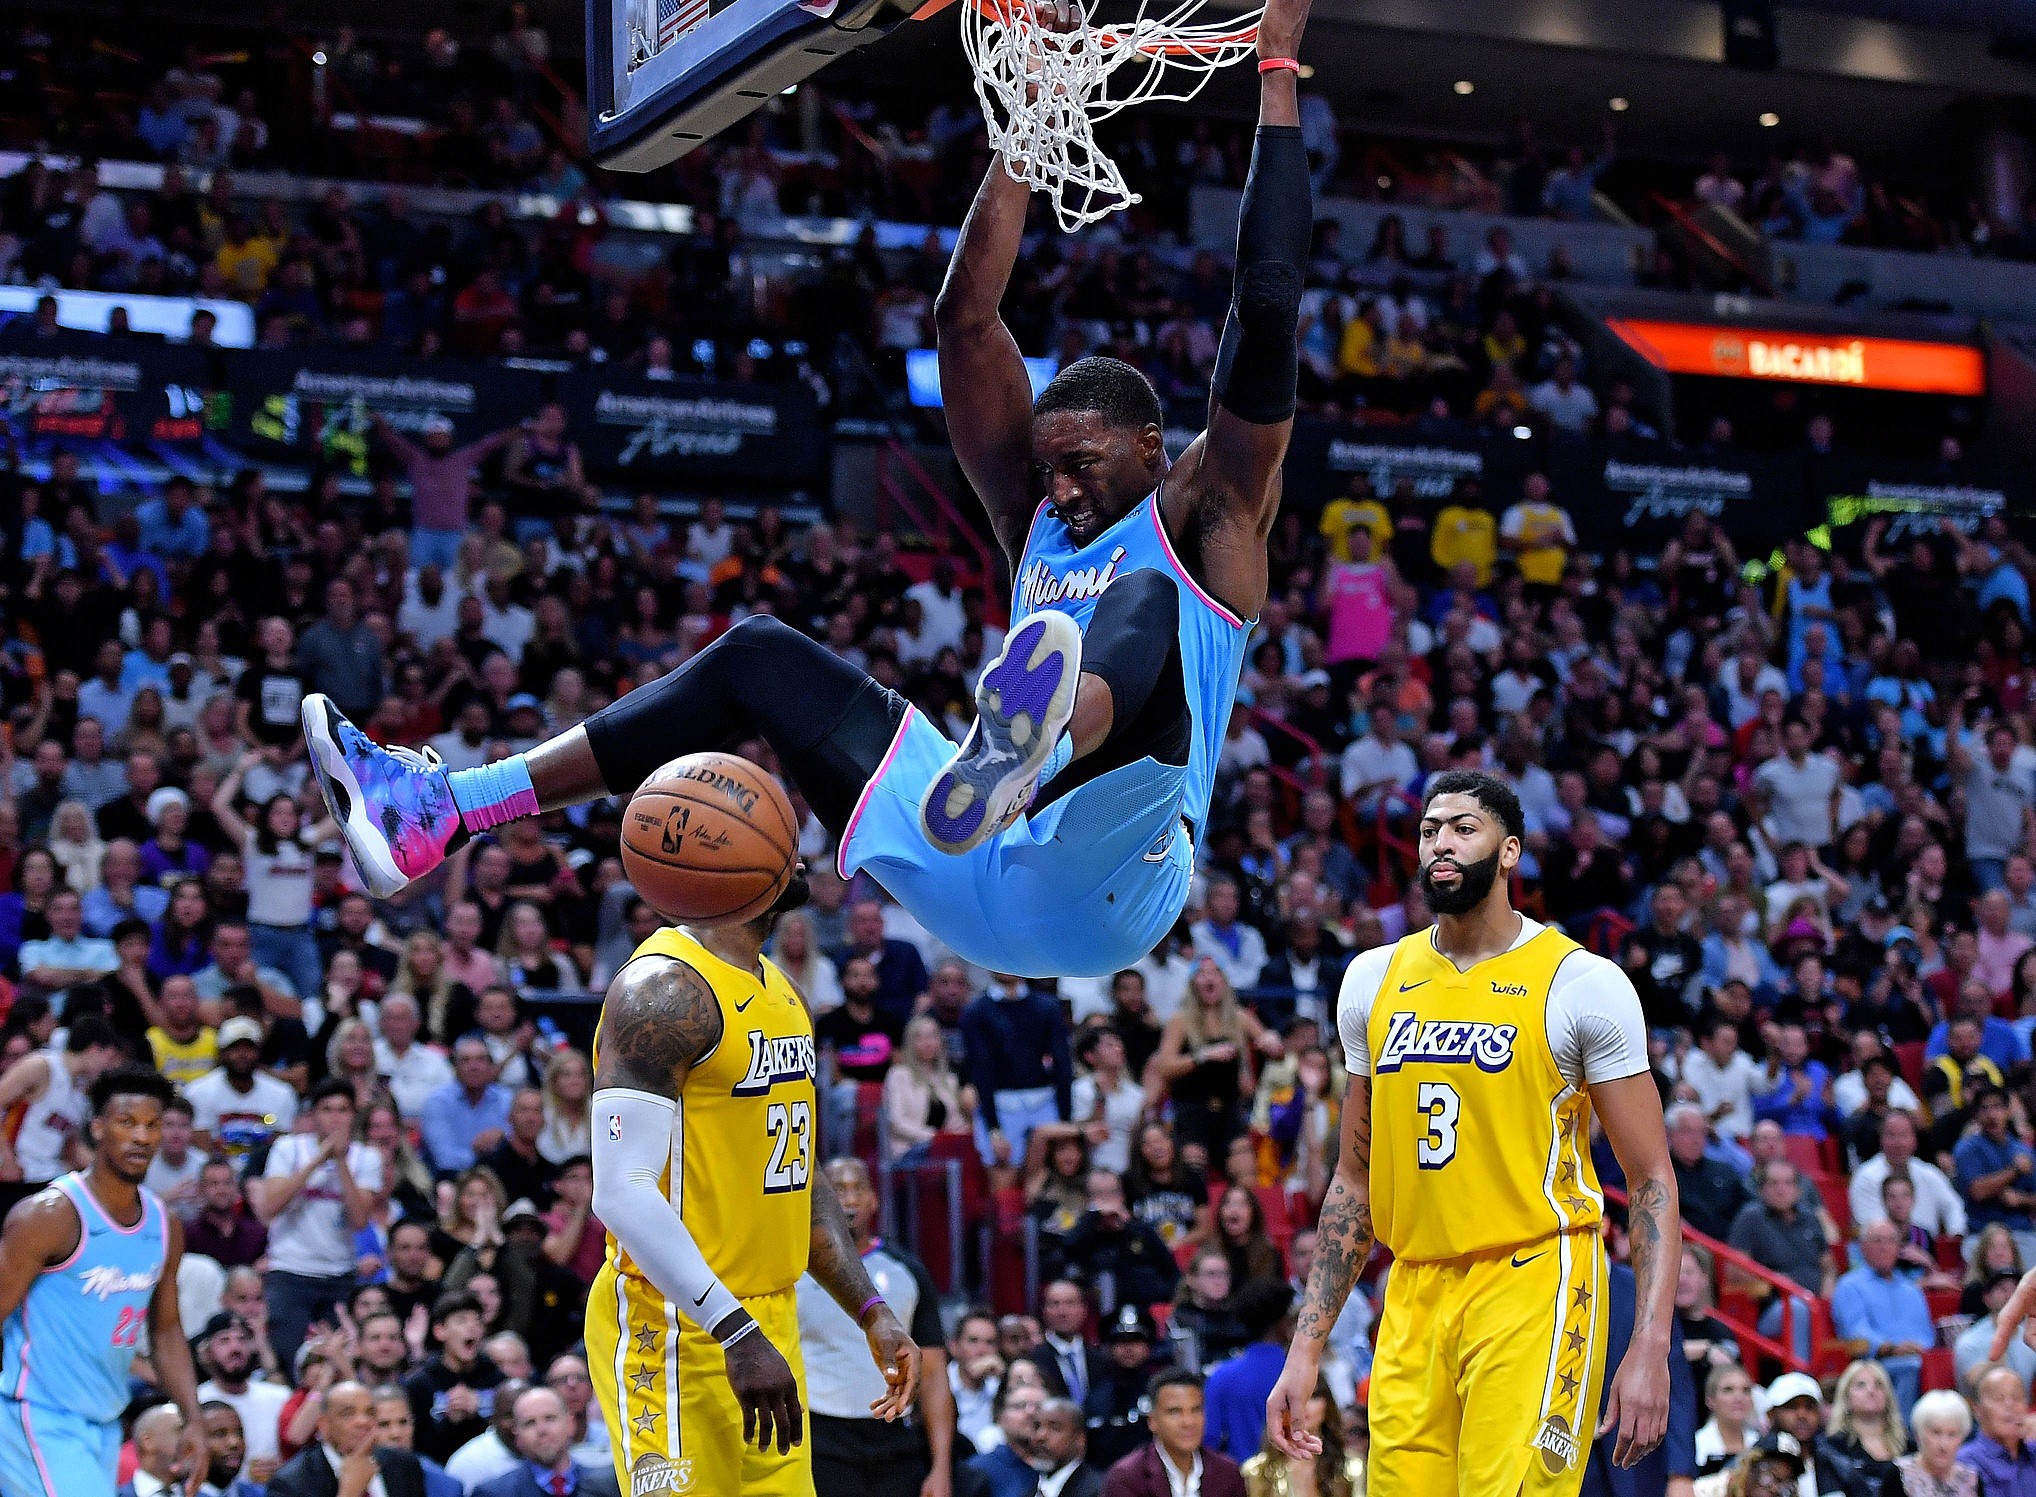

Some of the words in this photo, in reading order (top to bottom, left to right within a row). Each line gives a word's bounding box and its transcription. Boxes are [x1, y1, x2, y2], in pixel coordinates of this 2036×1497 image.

[1021, 546, 1132, 615] Miami
[1490, 981, 1528, 997] wish
[731, 1030, 817, 1097] LAKERS
[1376, 1012, 1518, 1074] LAKERS
[763, 1101, 811, 1194] 23
[1417, 1082, 1461, 1170] 3
